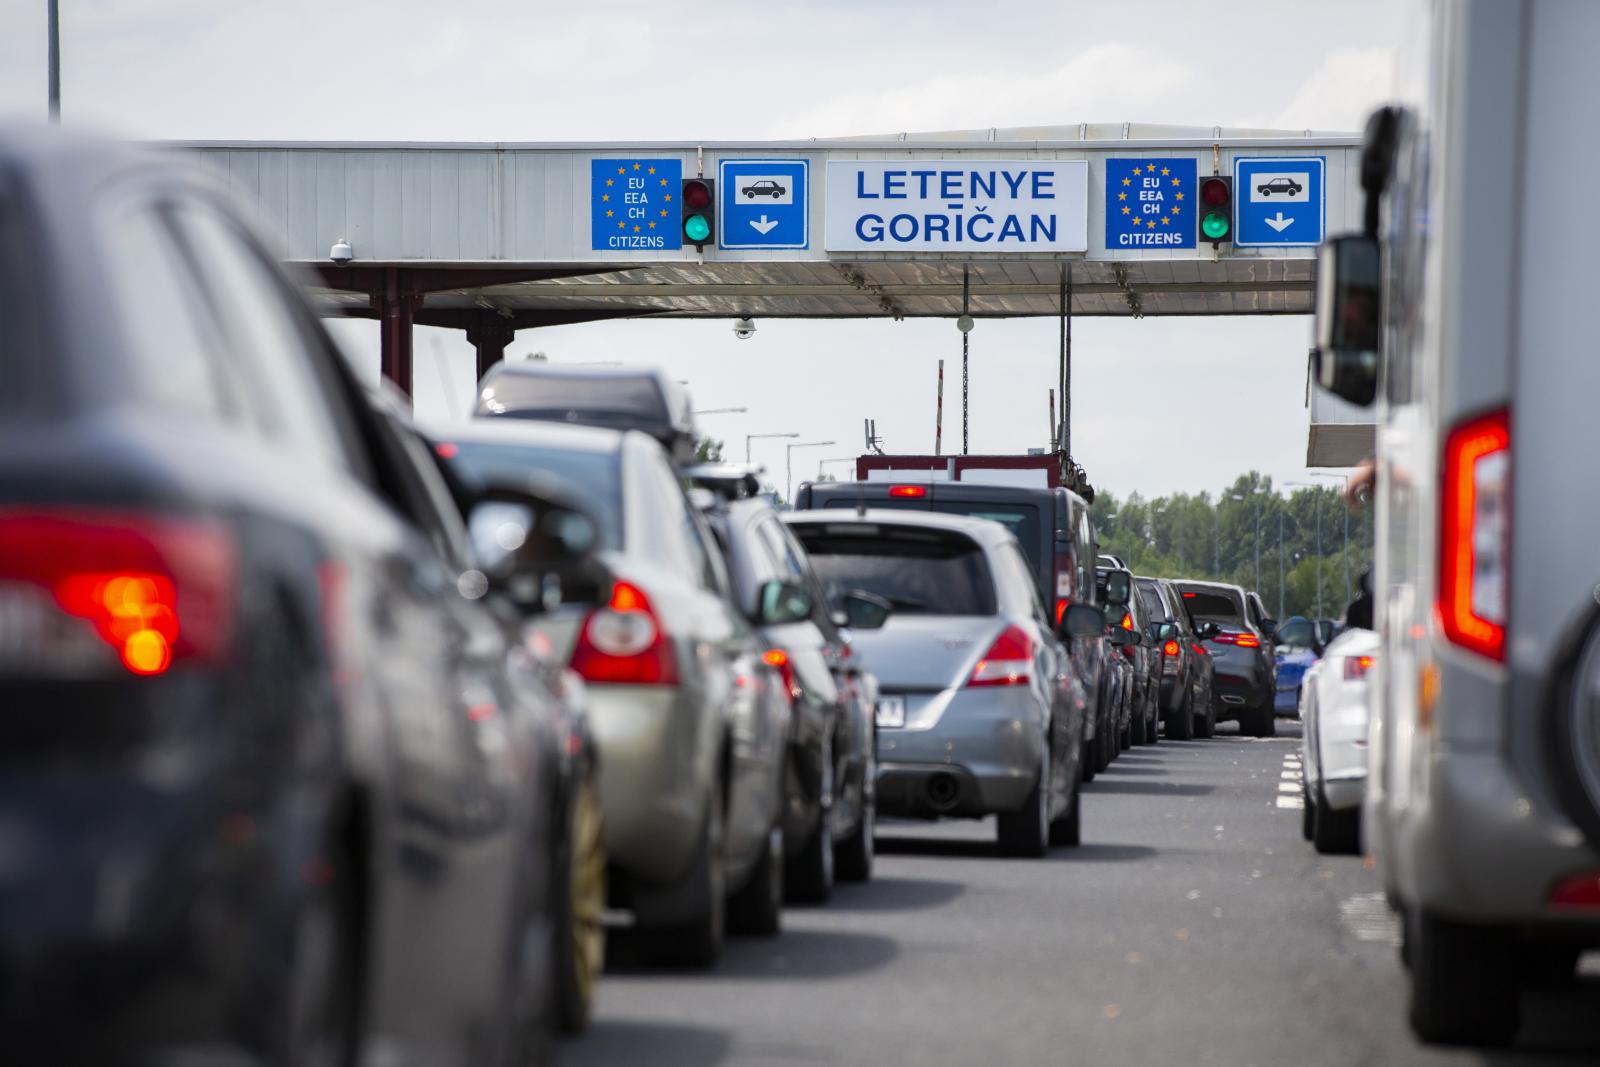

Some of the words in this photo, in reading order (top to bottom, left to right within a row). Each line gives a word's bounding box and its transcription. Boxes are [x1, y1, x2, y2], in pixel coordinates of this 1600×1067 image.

[629, 178, 644, 188] EU
[857, 171, 1055, 199] LETENYE
[1143, 178, 1160, 188] EU
[625, 193, 648, 203] EEA
[1139, 191, 1164, 201] EEA
[628, 207, 645, 219] CH
[1143, 204, 1160, 214] CH
[855, 206, 1056, 242] GORIČAN
[609, 236, 664, 248] CITIZENS
[1120, 233, 1182, 245] CITIZENS
